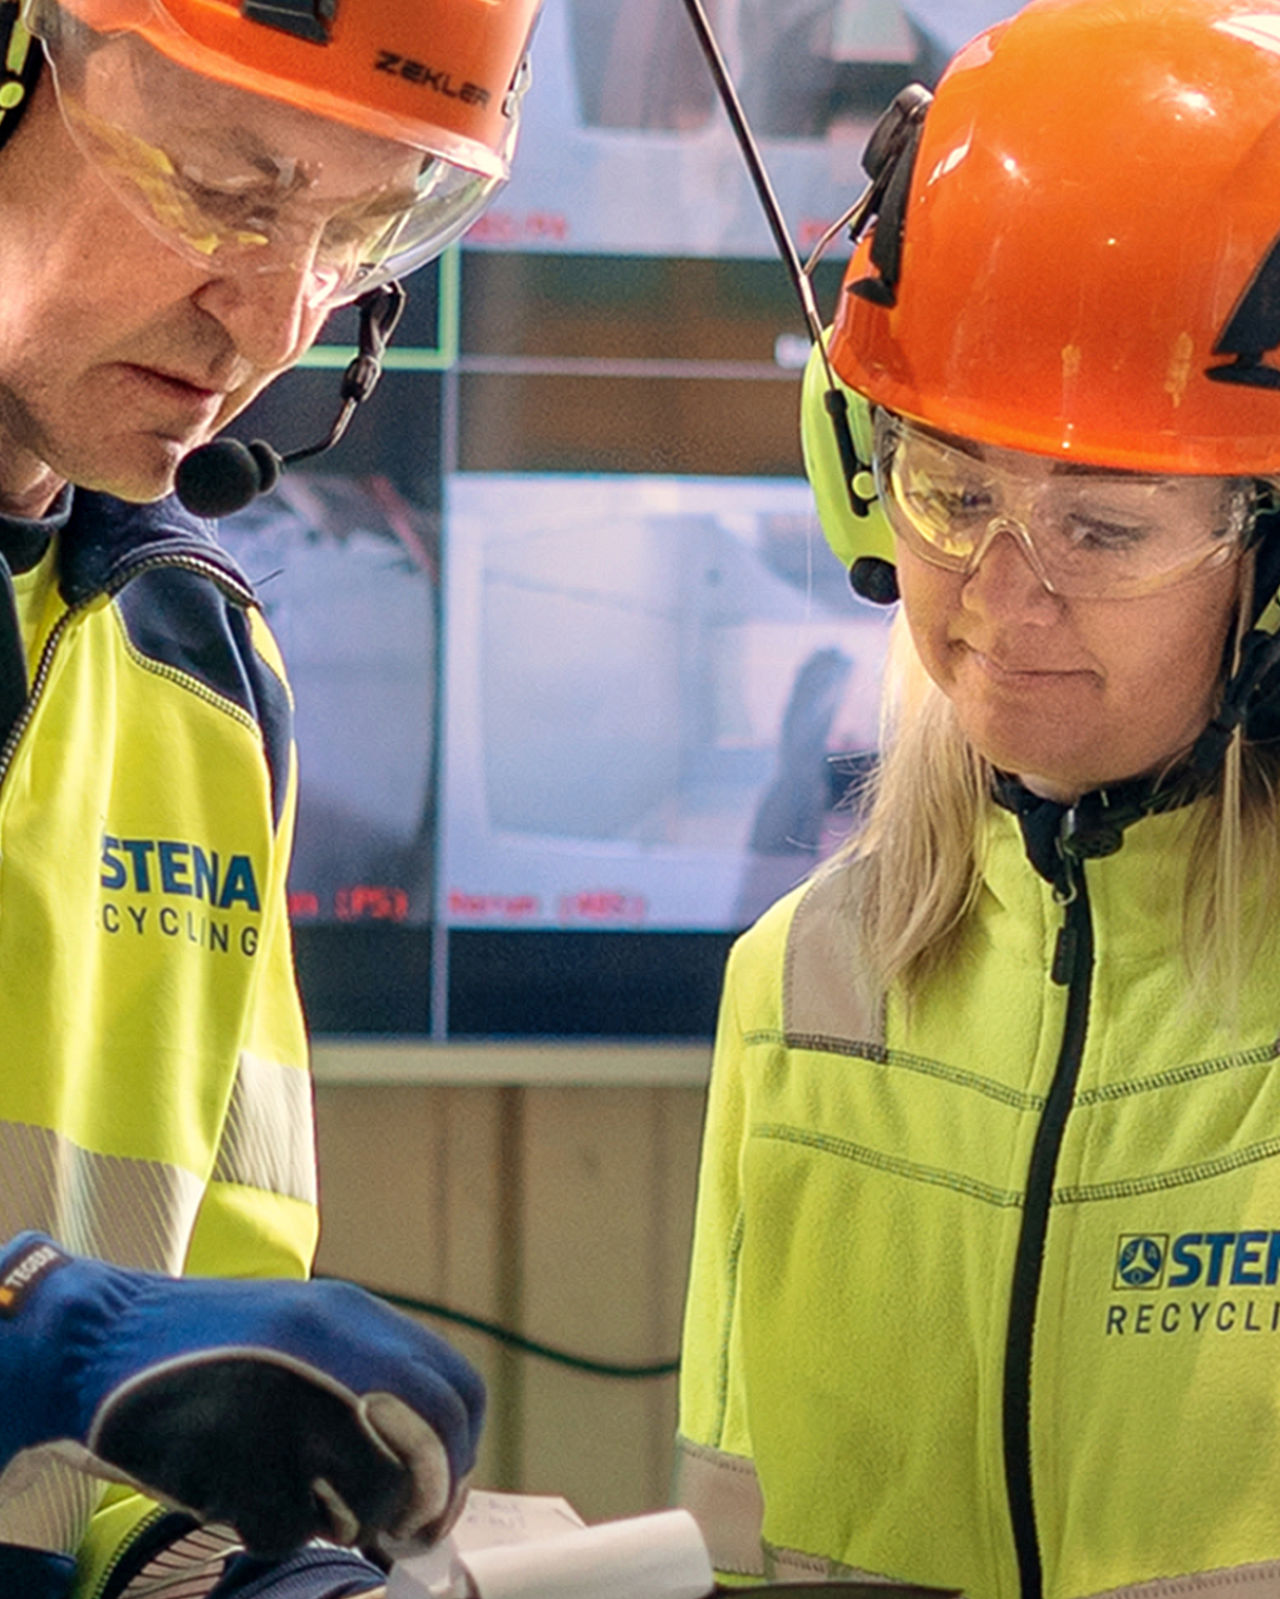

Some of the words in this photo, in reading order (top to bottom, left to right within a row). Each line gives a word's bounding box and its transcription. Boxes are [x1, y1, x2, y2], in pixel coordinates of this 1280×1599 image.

[375, 51, 490, 110] ZEKLER
[101, 834, 261, 912] STENA
[102, 903, 259, 957] CYCLING
